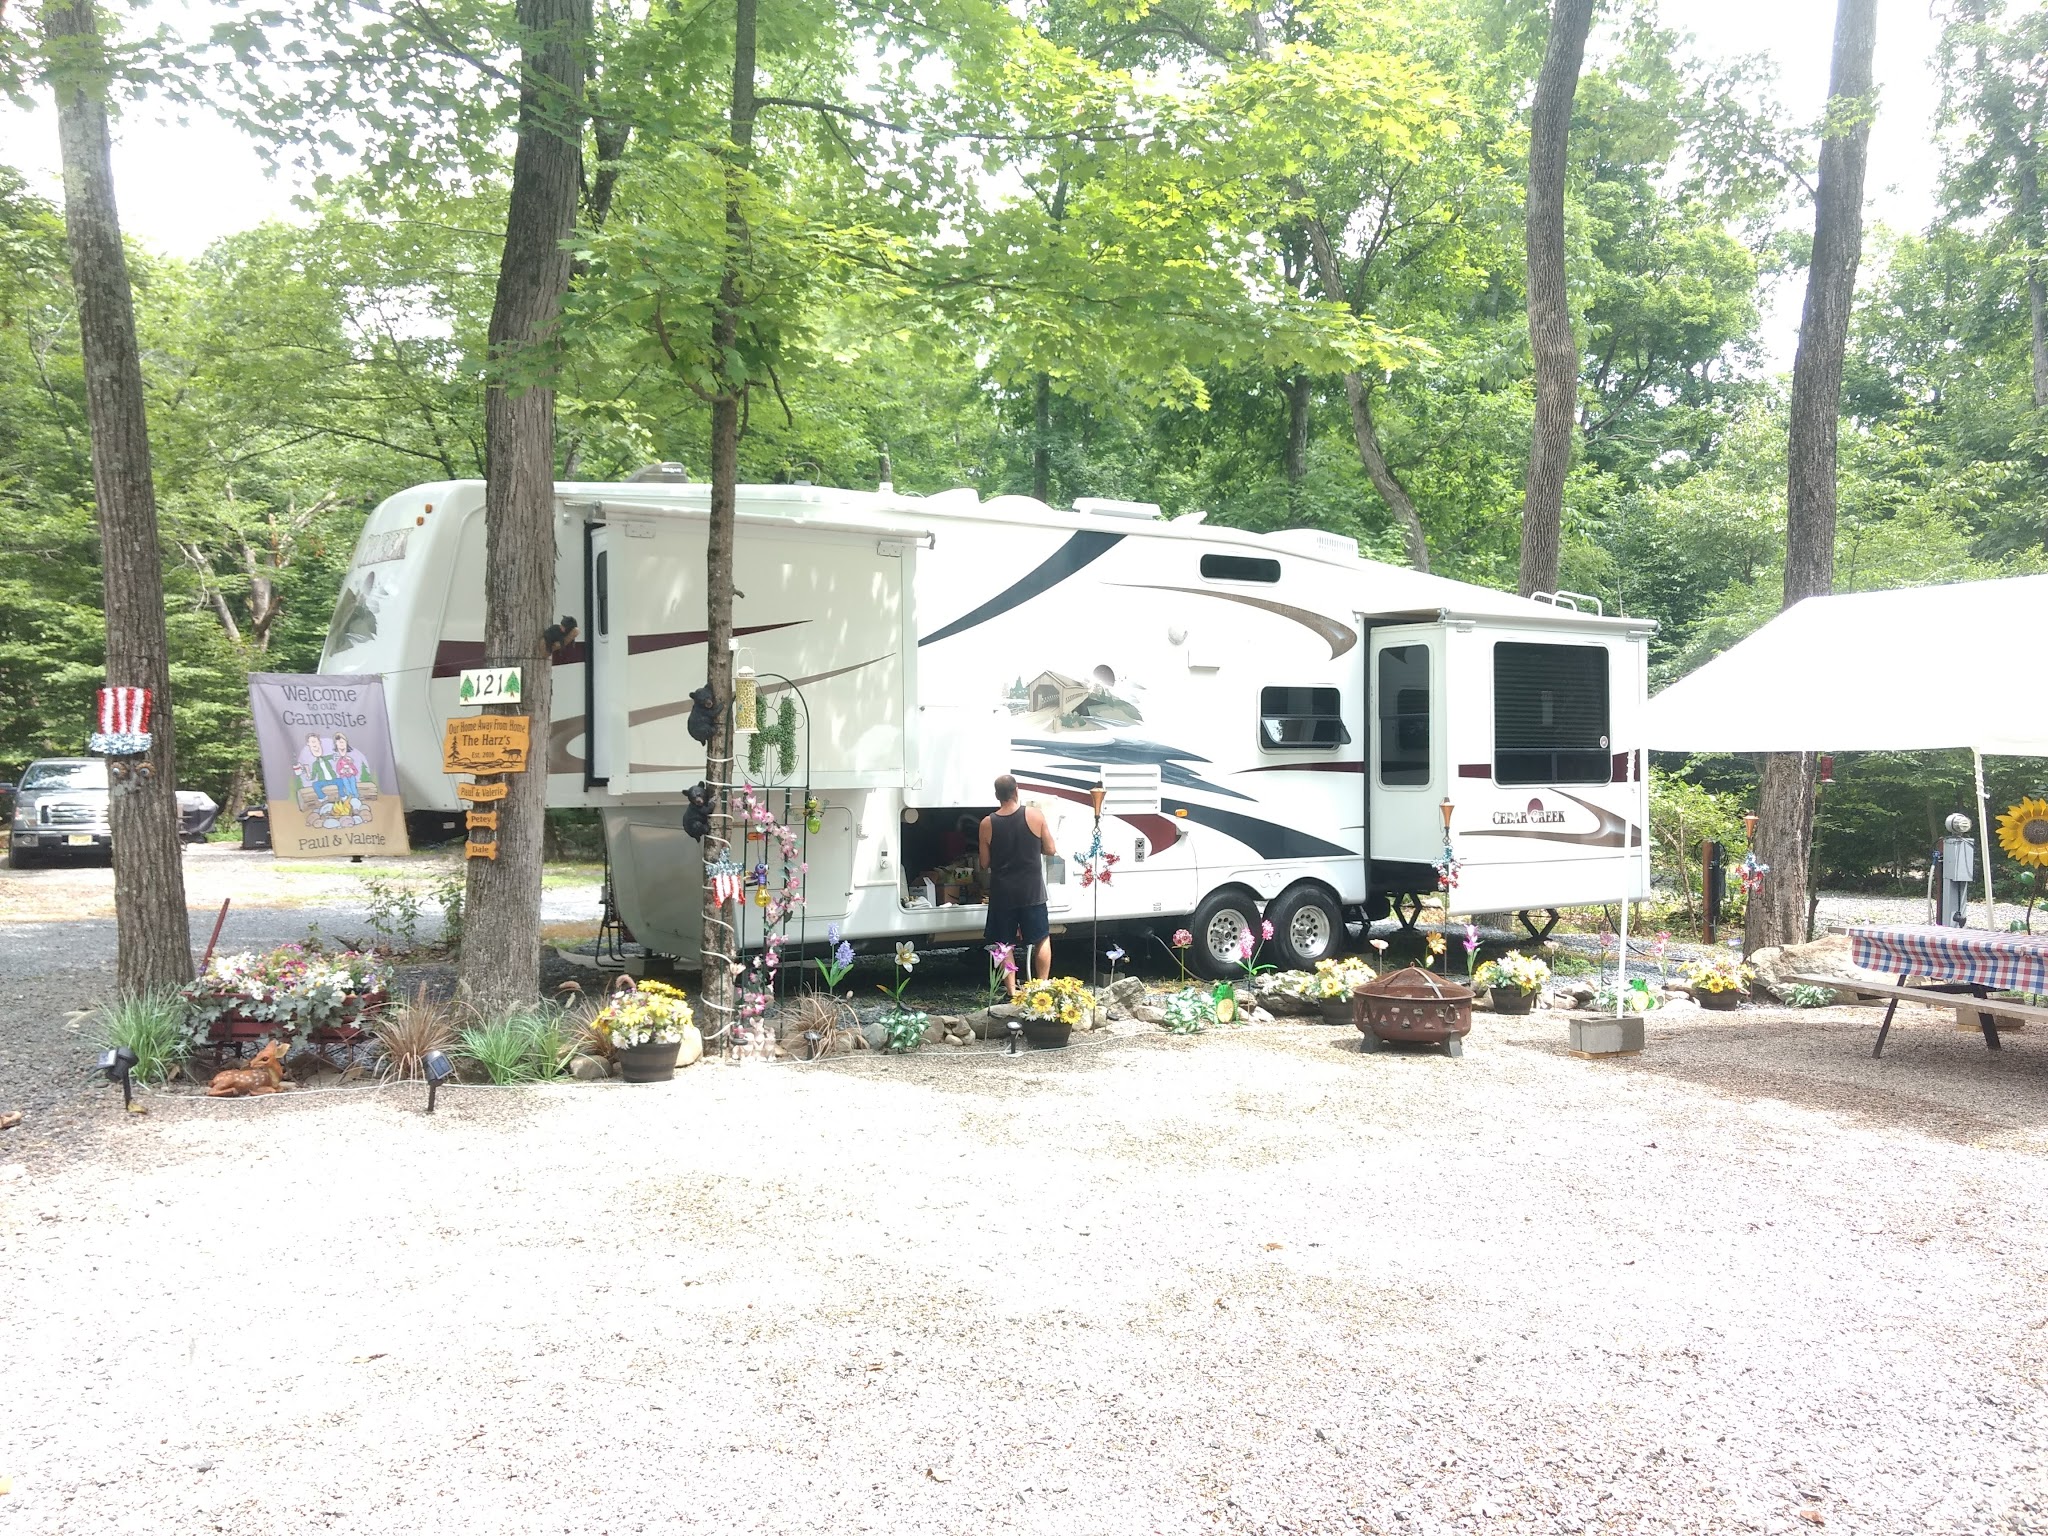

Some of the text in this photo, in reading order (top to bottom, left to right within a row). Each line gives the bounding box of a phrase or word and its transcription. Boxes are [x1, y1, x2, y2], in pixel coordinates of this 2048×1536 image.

[475, 673, 503, 697] 121
[281, 685, 357, 702] Welcome
[307, 703, 337, 711] to our
[282, 710, 367, 729] Campsite
[448, 718, 526, 735] Our Home Away From Home
[462, 733, 511, 747] The Harz's
[460, 786, 504, 797] Paul & Valerie
[471, 815, 492, 825] Petey
[1492, 810, 1566, 825] CEDAR CREEK
[298, 832, 386, 851] Paul & Valerie
[472, 845, 490, 854] Dale
